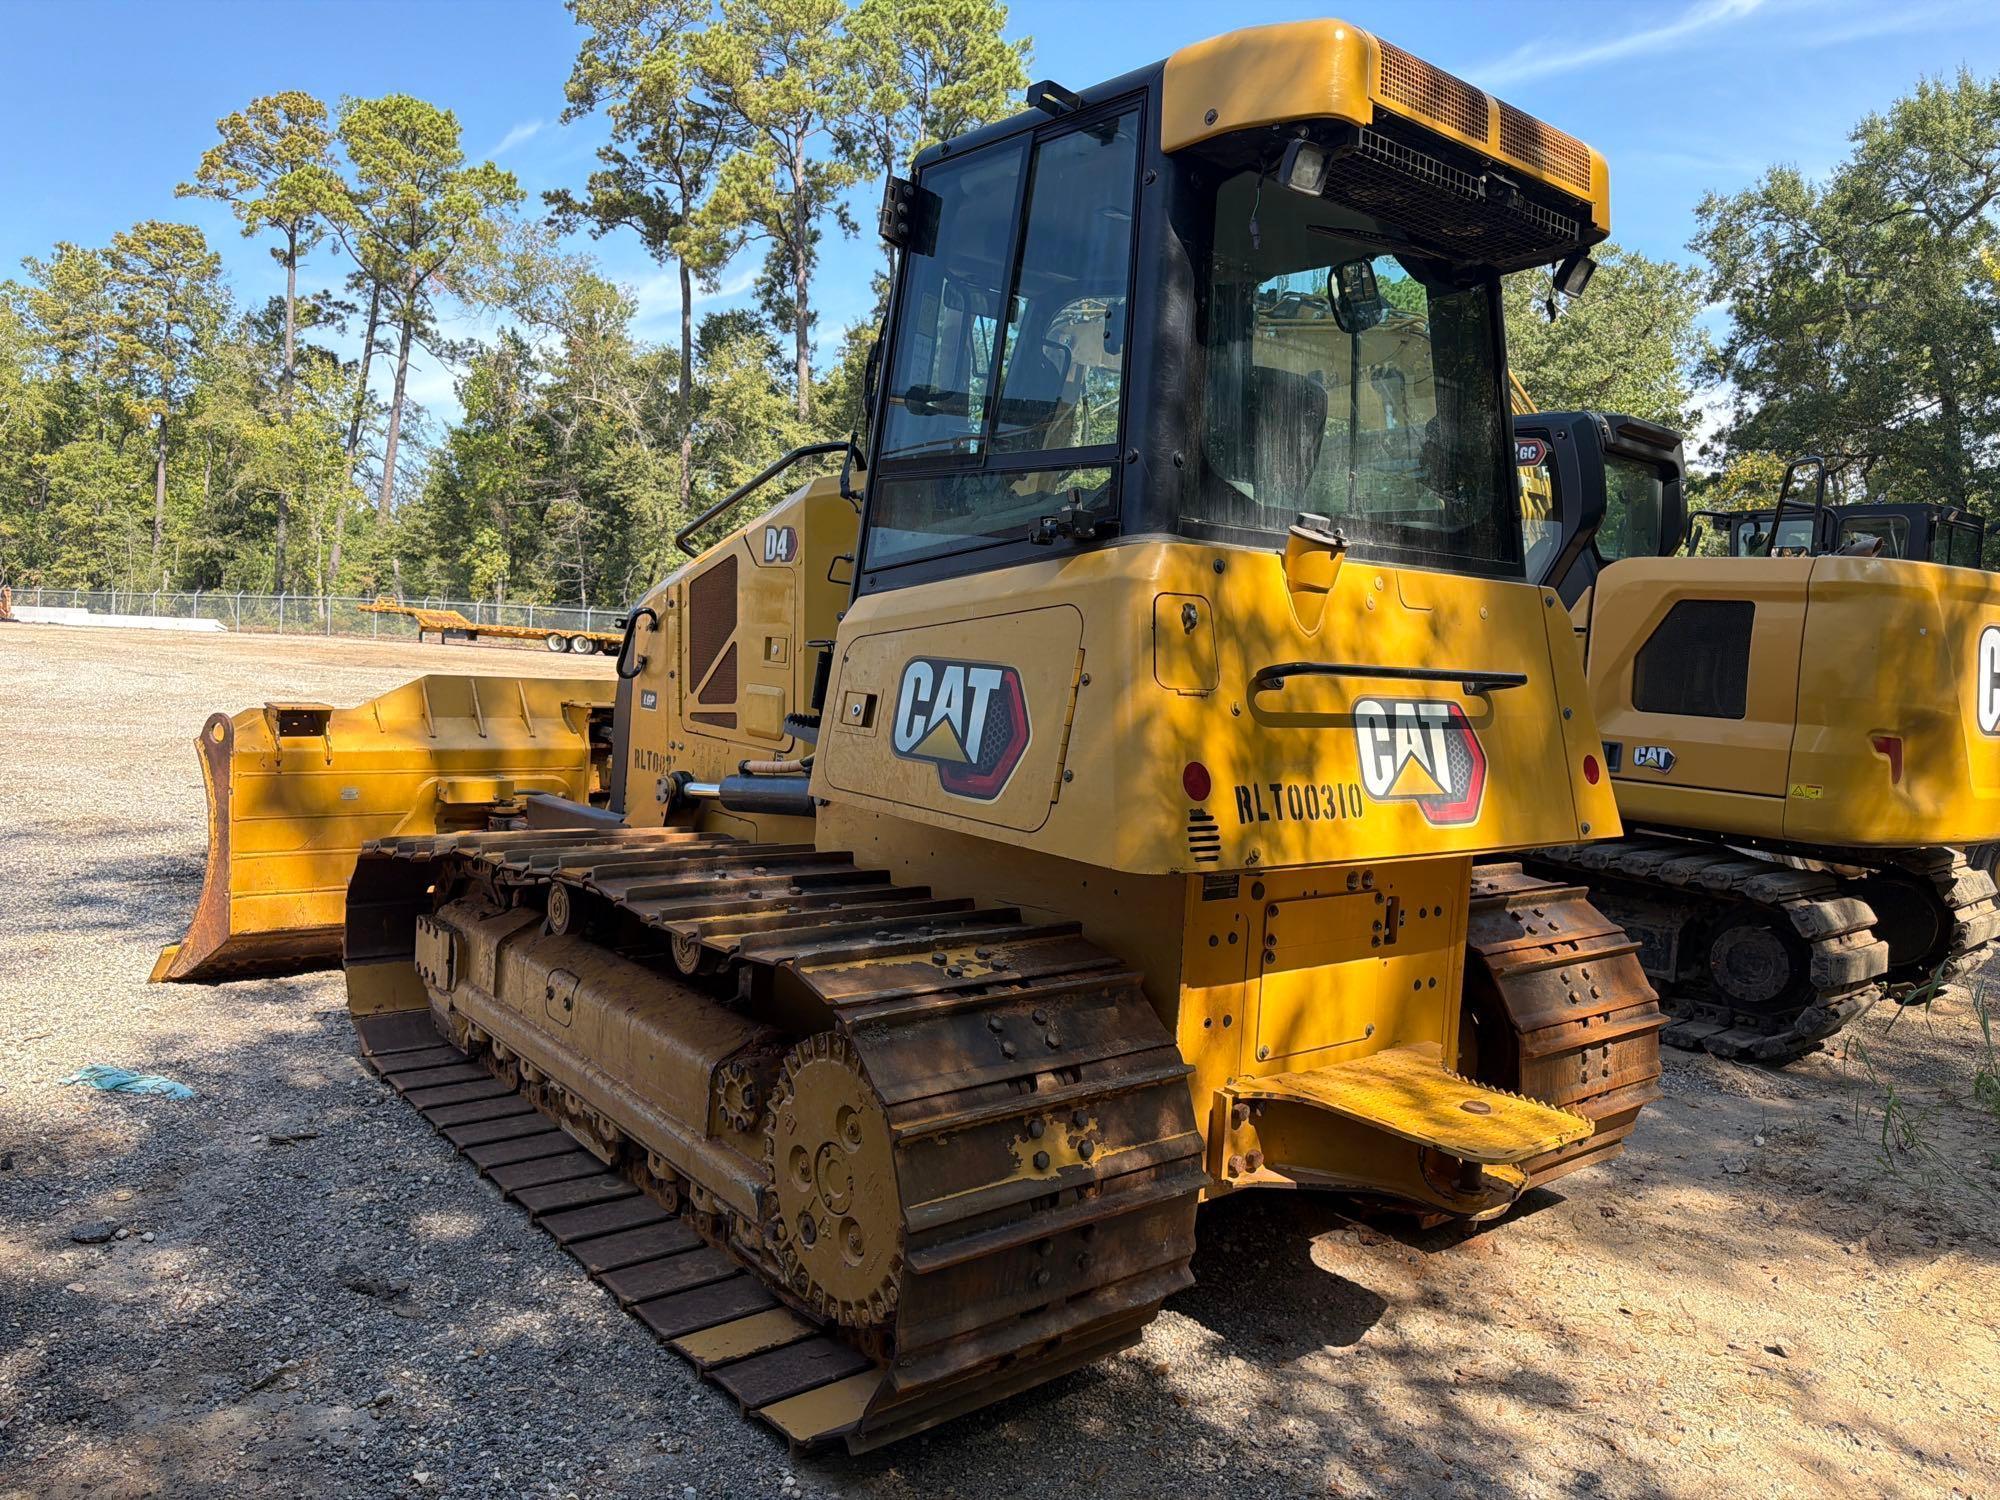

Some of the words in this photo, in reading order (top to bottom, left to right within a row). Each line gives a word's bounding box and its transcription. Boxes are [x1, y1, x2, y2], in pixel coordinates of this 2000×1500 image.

[765, 528, 788, 561] D4
[894, 661, 1003, 764] CAT
[1355, 700, 1453, 796] CAT
[1633, 747, 1669, 768] CAT
[1234, 782, 1363, 824] RLT00310
